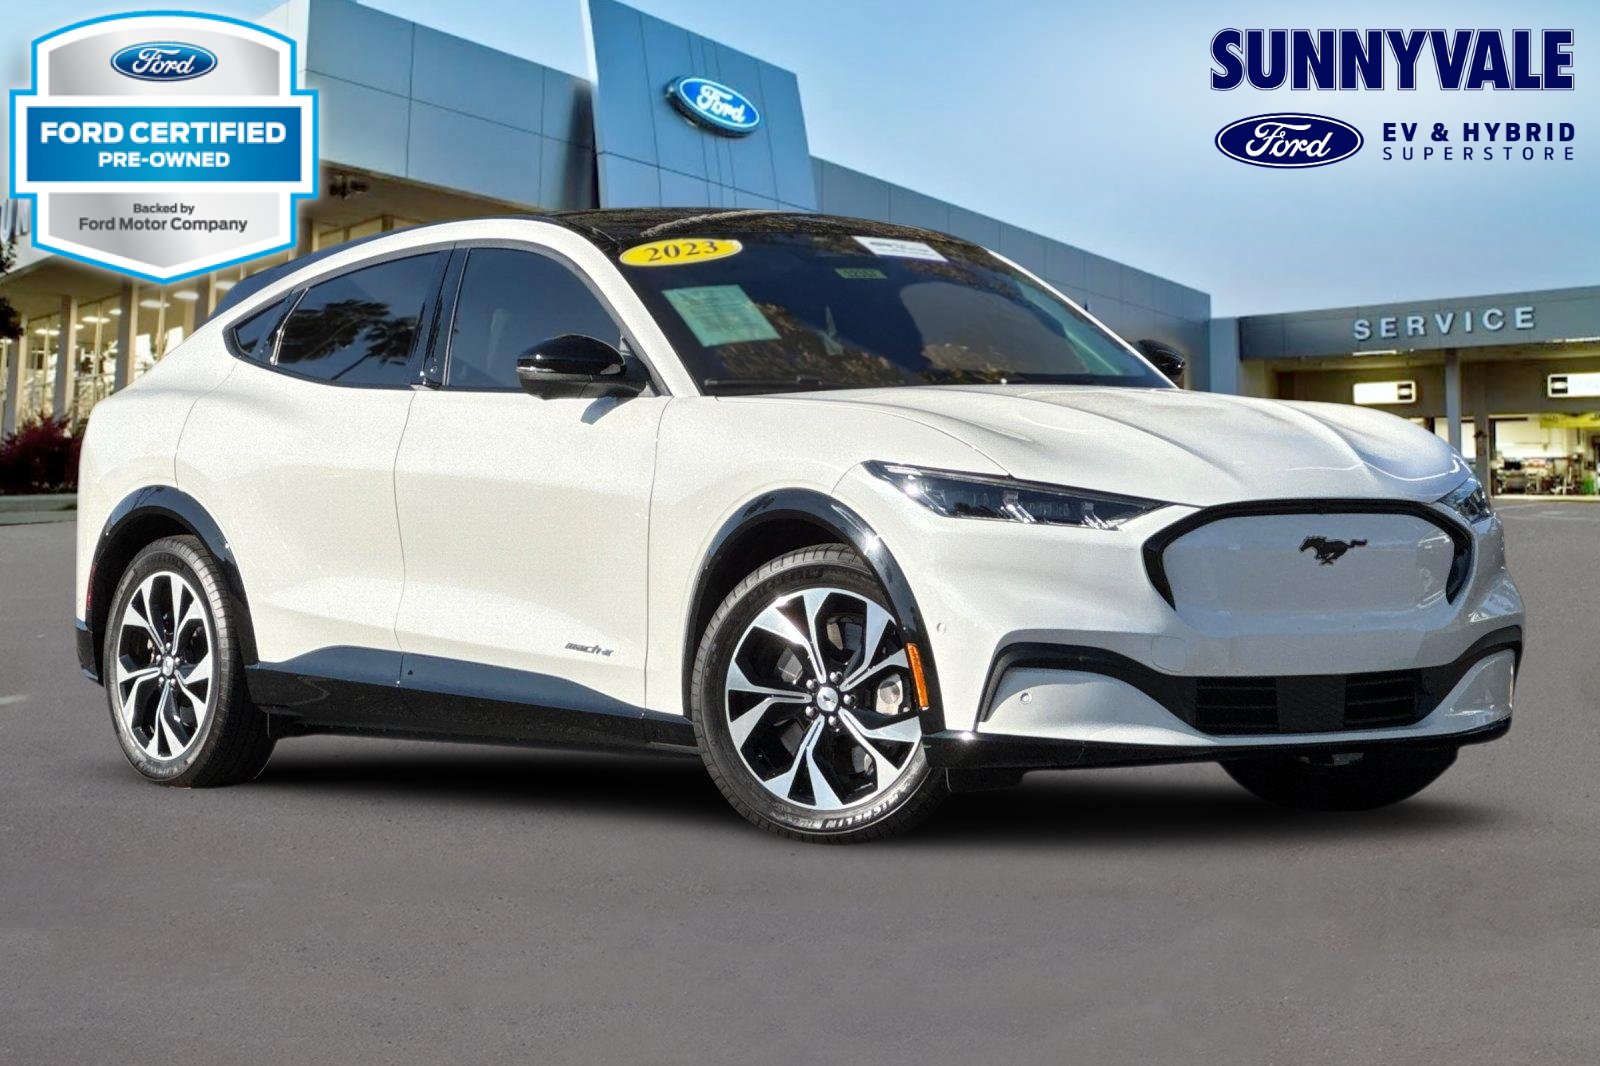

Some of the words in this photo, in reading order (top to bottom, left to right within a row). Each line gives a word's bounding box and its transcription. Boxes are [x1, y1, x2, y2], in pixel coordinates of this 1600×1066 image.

[697, 85, 746, 122] Ford
[647, 240, 719, 262] 2023
[1353, 306, 1535, 341] SERVICE
